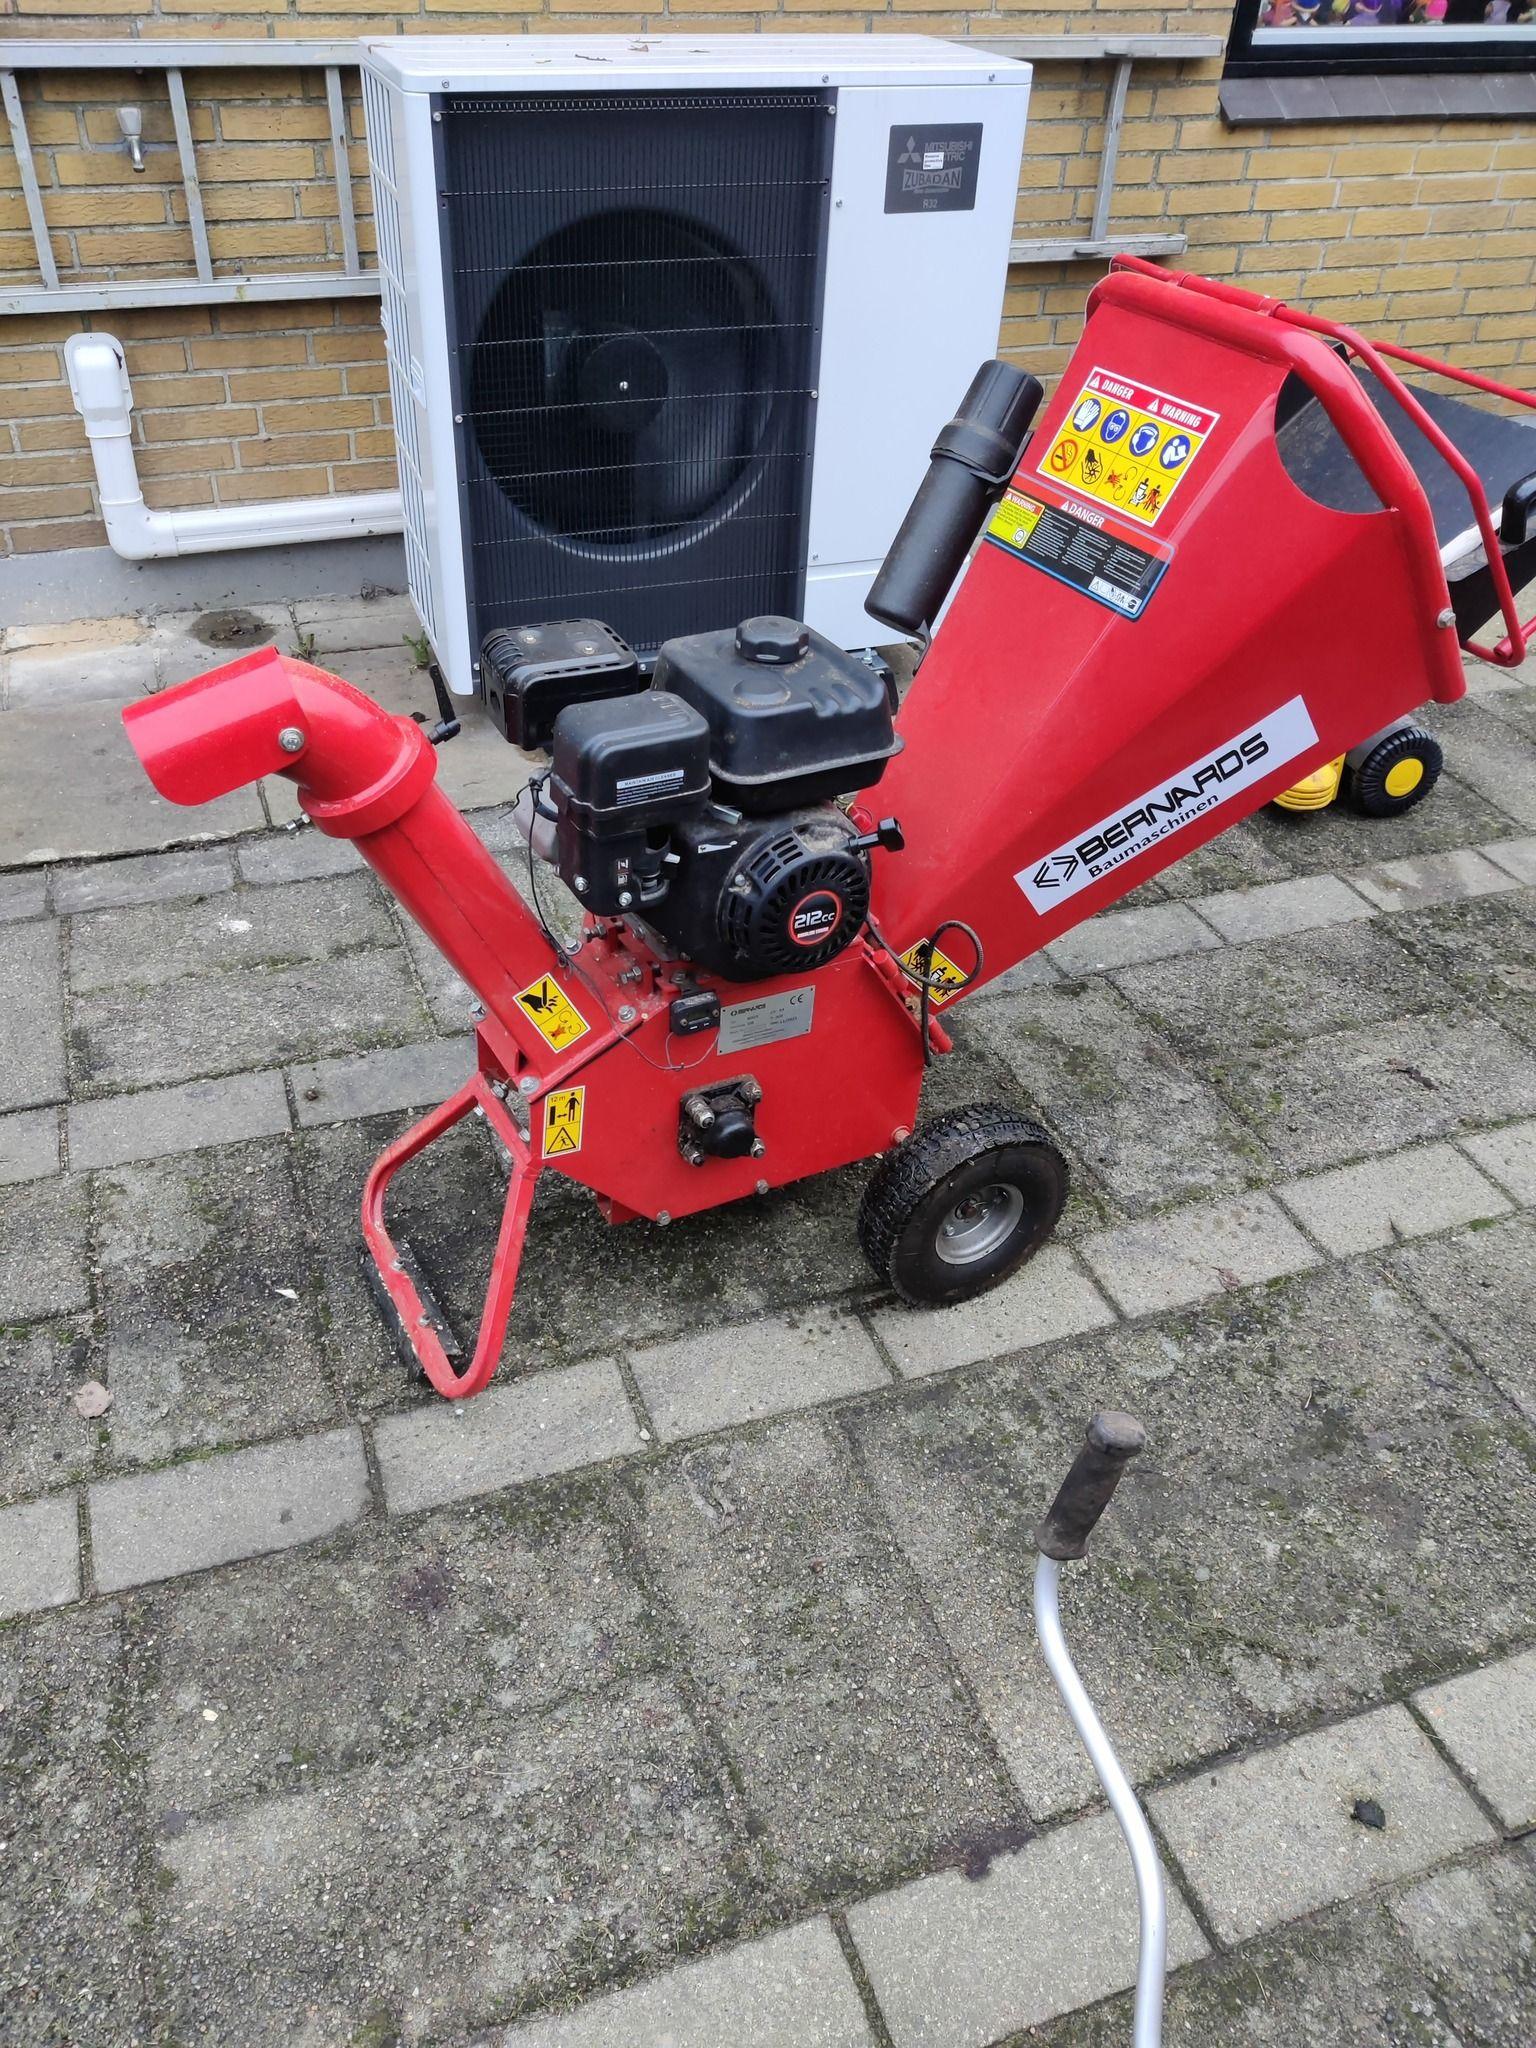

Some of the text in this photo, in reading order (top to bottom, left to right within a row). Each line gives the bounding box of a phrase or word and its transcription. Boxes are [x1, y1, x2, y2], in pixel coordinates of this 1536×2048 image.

[924, 141, 973, 152] MITSUBISHI
[903, 170, 961, 189] ZUBADAN
[1101, 379, 1135, 400] DANGER
[1161, 403, 1202, 428] WARNING
[1070, 502, 1105, 529] DANGER
[1075, 732, 1269, 866] BERNARDS
[1088, 794, 1219, 878] Baumaschinen
[794, 910, 835, 929] 212cc
